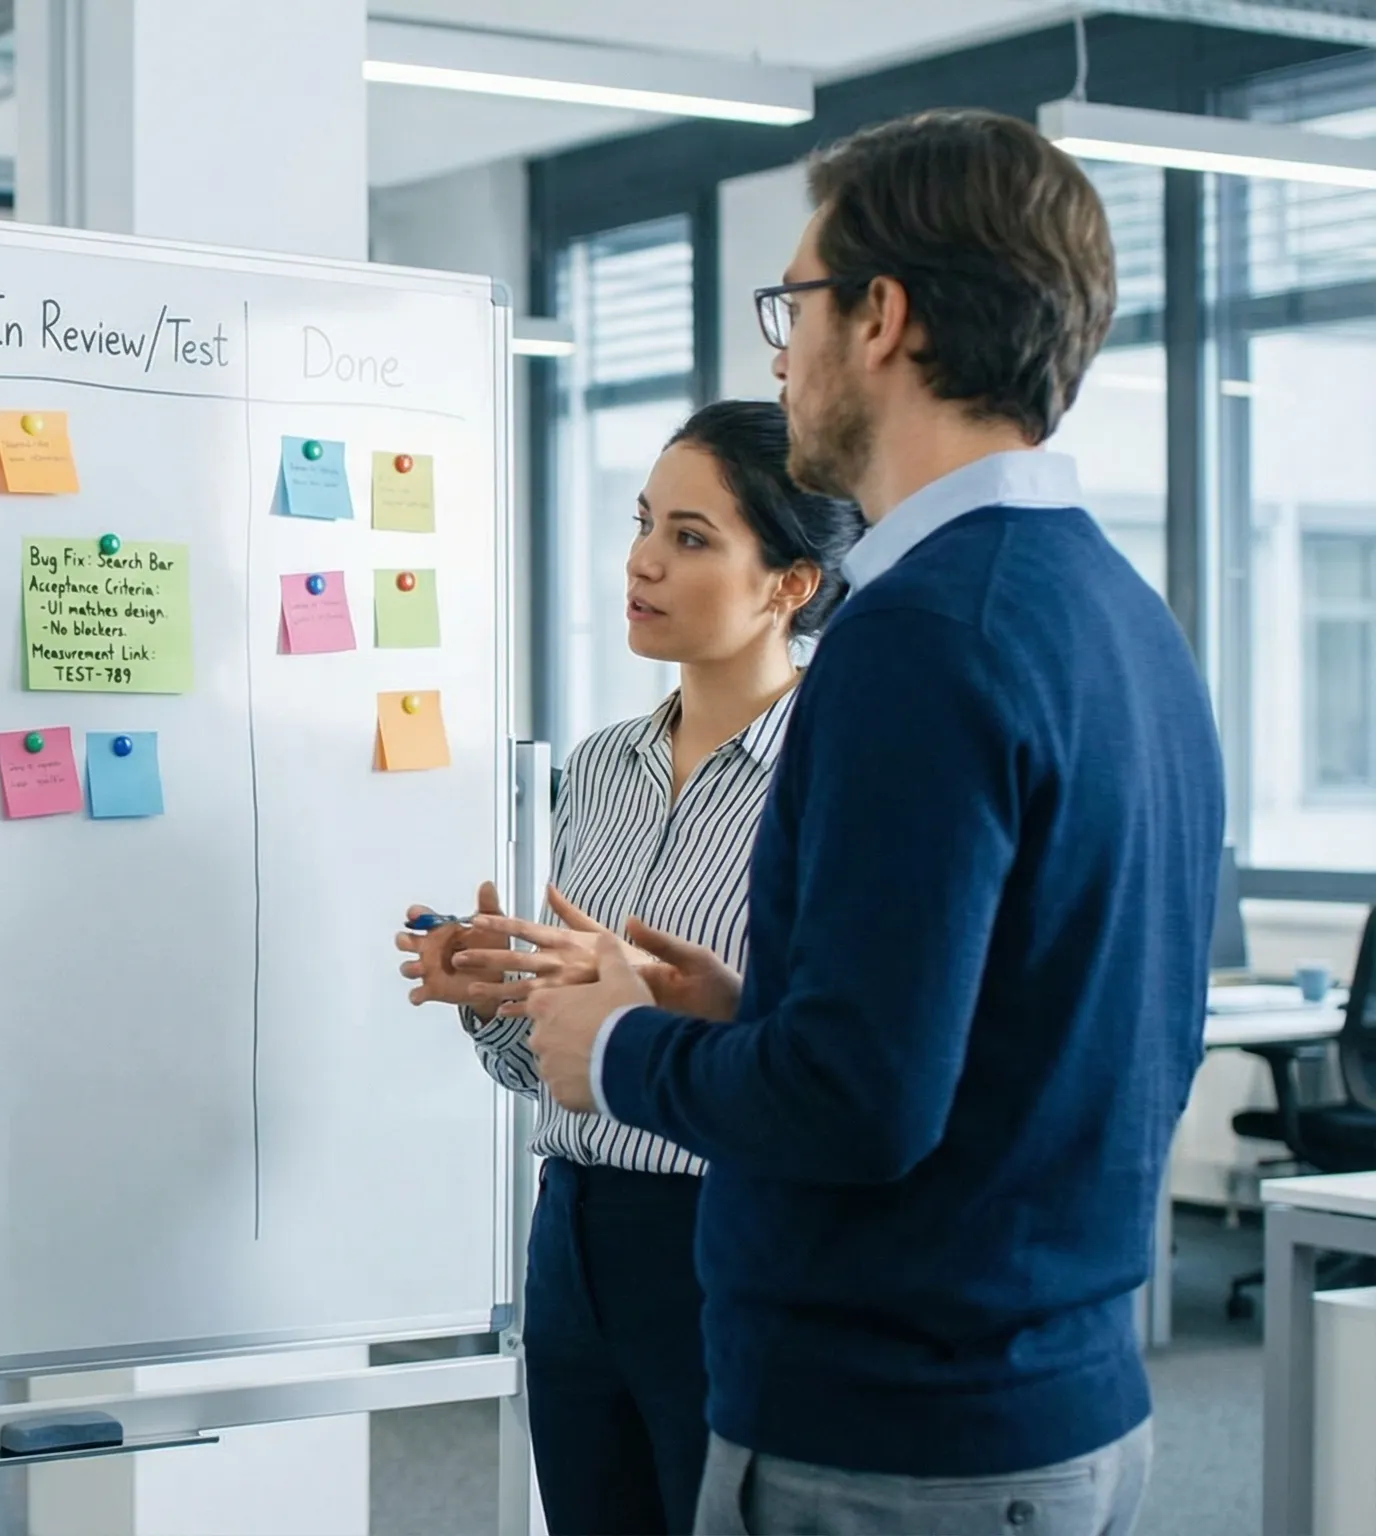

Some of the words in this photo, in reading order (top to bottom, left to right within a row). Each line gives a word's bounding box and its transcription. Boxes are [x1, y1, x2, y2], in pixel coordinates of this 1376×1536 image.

[42, 298, 229, 373] Review/Test
[302, 325, 405, 388] Done
[29, 545, 58, 575] Bug
[64, 547, 92, 567] Fix:
[97, 551, 143, 570] Search
[149, 551, 175, 571] Bar
[29, 575, 99, 599] Acceptance
[105, 577, 160, 597] Criteria:
[68, 601, 118, 618] matches
[73, 620, 127, 637] blockers.
[31, 642, 115, 661] Measurement
[122, 645, 156, 661] Link:
[53, 665, 132, 684] TEST-789
